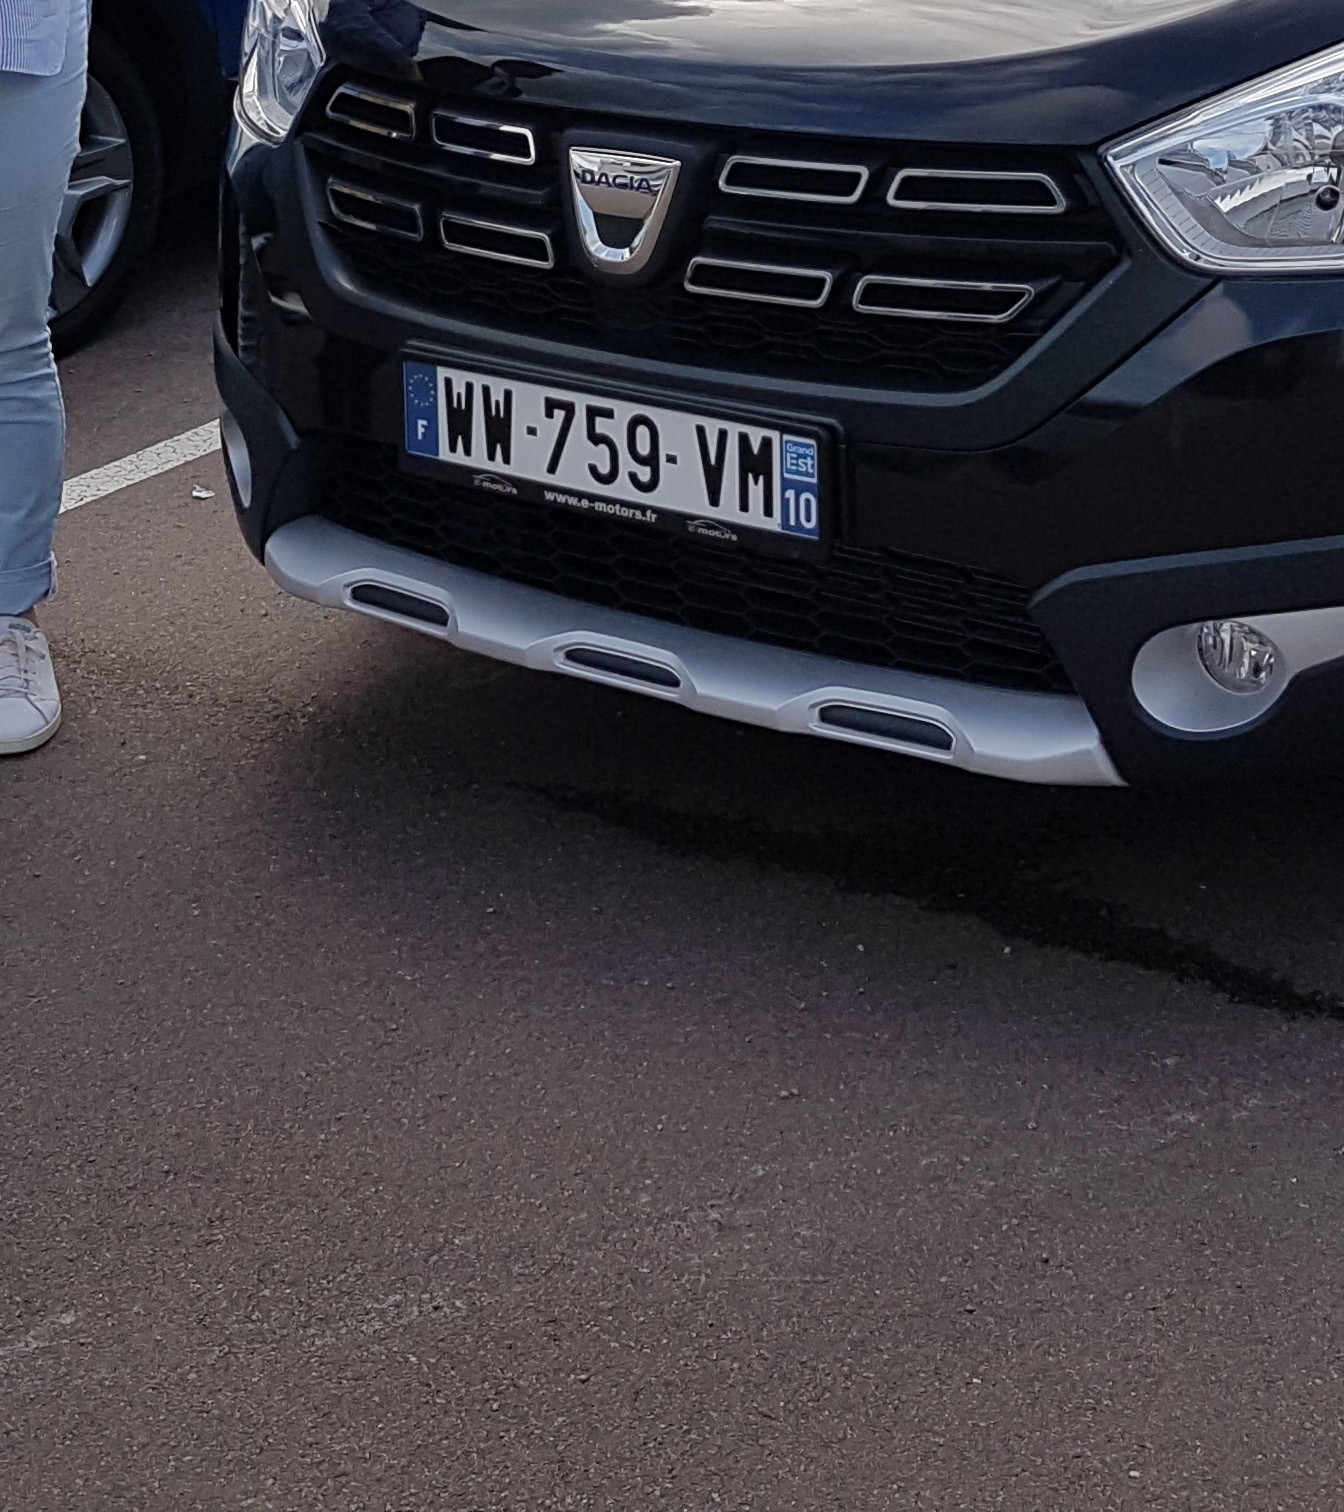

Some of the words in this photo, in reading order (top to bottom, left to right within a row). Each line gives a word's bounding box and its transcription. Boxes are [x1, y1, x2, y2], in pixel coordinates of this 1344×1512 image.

[579, 169, 655, 194] DACIA
[416, 419, 428, 441] F
[786, 442, 814, 456] Grand
[786, 452, 814, 473] Est
[544, 489, 658, 524] www.e-motors.fr
[784, 488, 817, 529] 10
